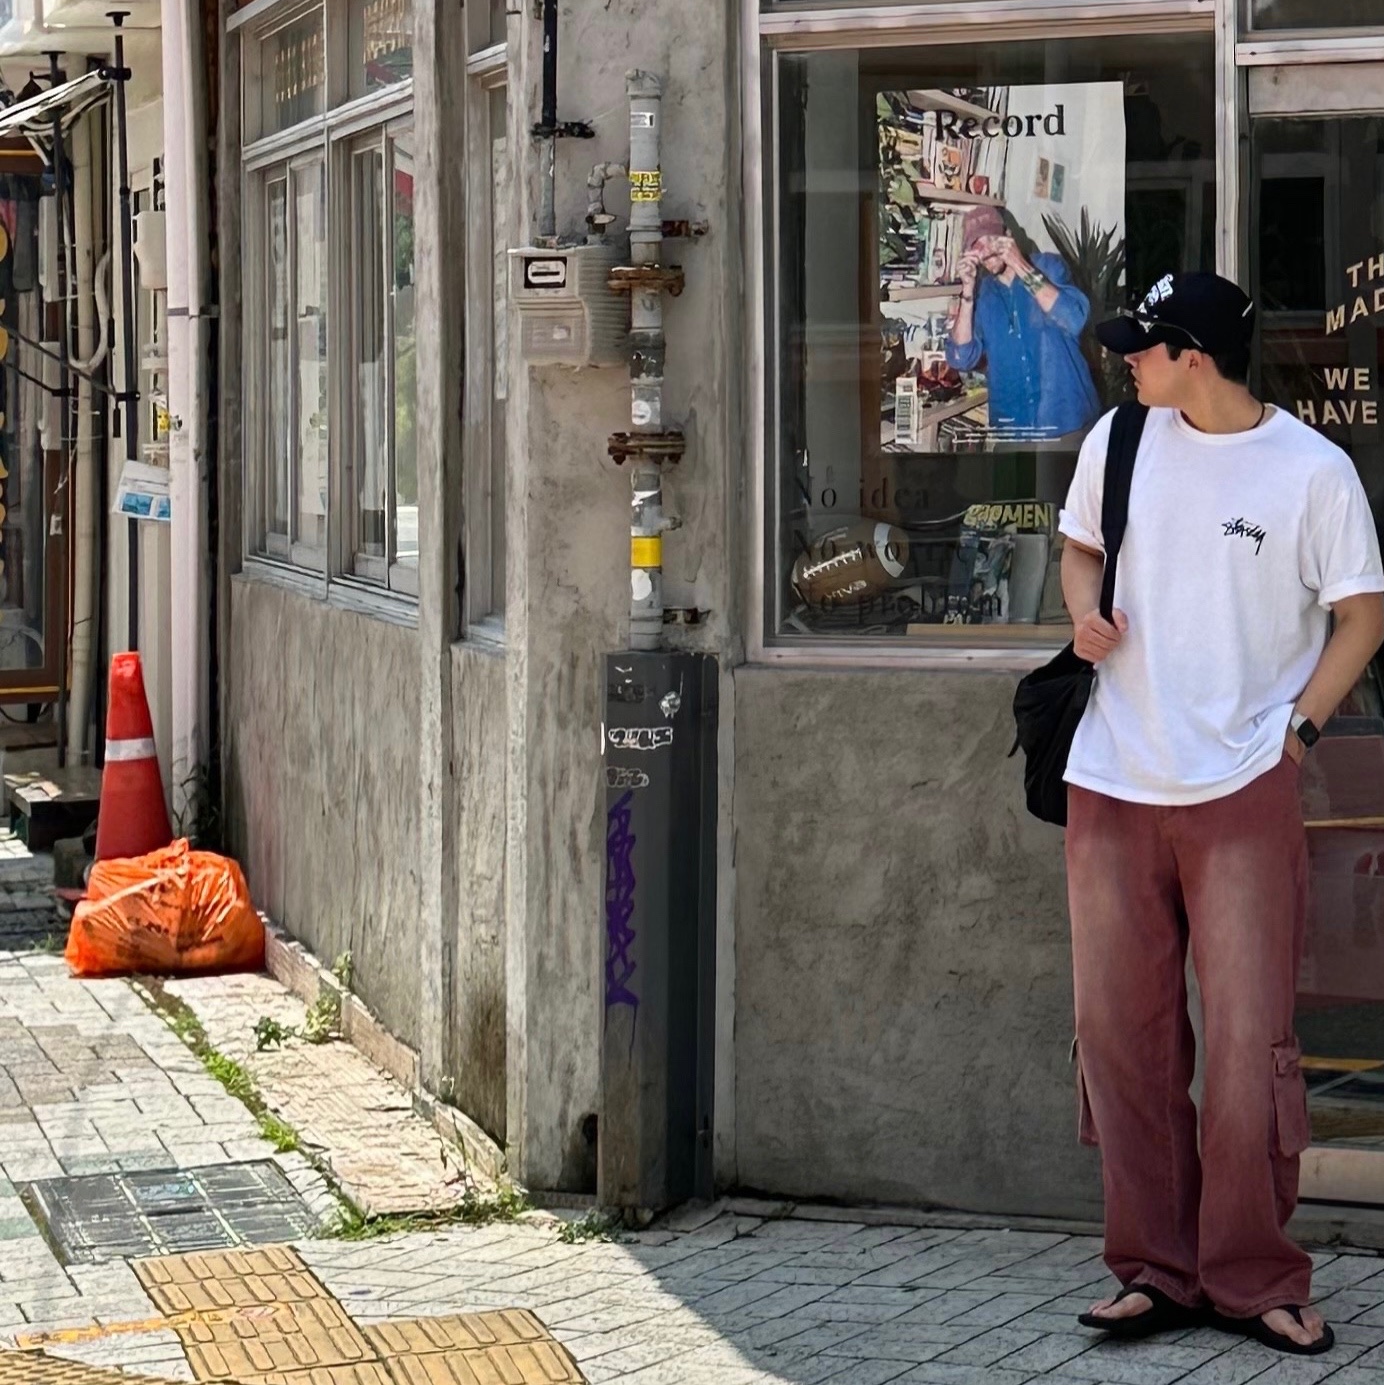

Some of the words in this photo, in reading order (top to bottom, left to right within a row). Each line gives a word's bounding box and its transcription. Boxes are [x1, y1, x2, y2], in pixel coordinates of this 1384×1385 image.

[933, 104, 1065, 141] Record
[1325, 367, 1370, 390] WE
[1297, 400, 1378, 424] HAVE
